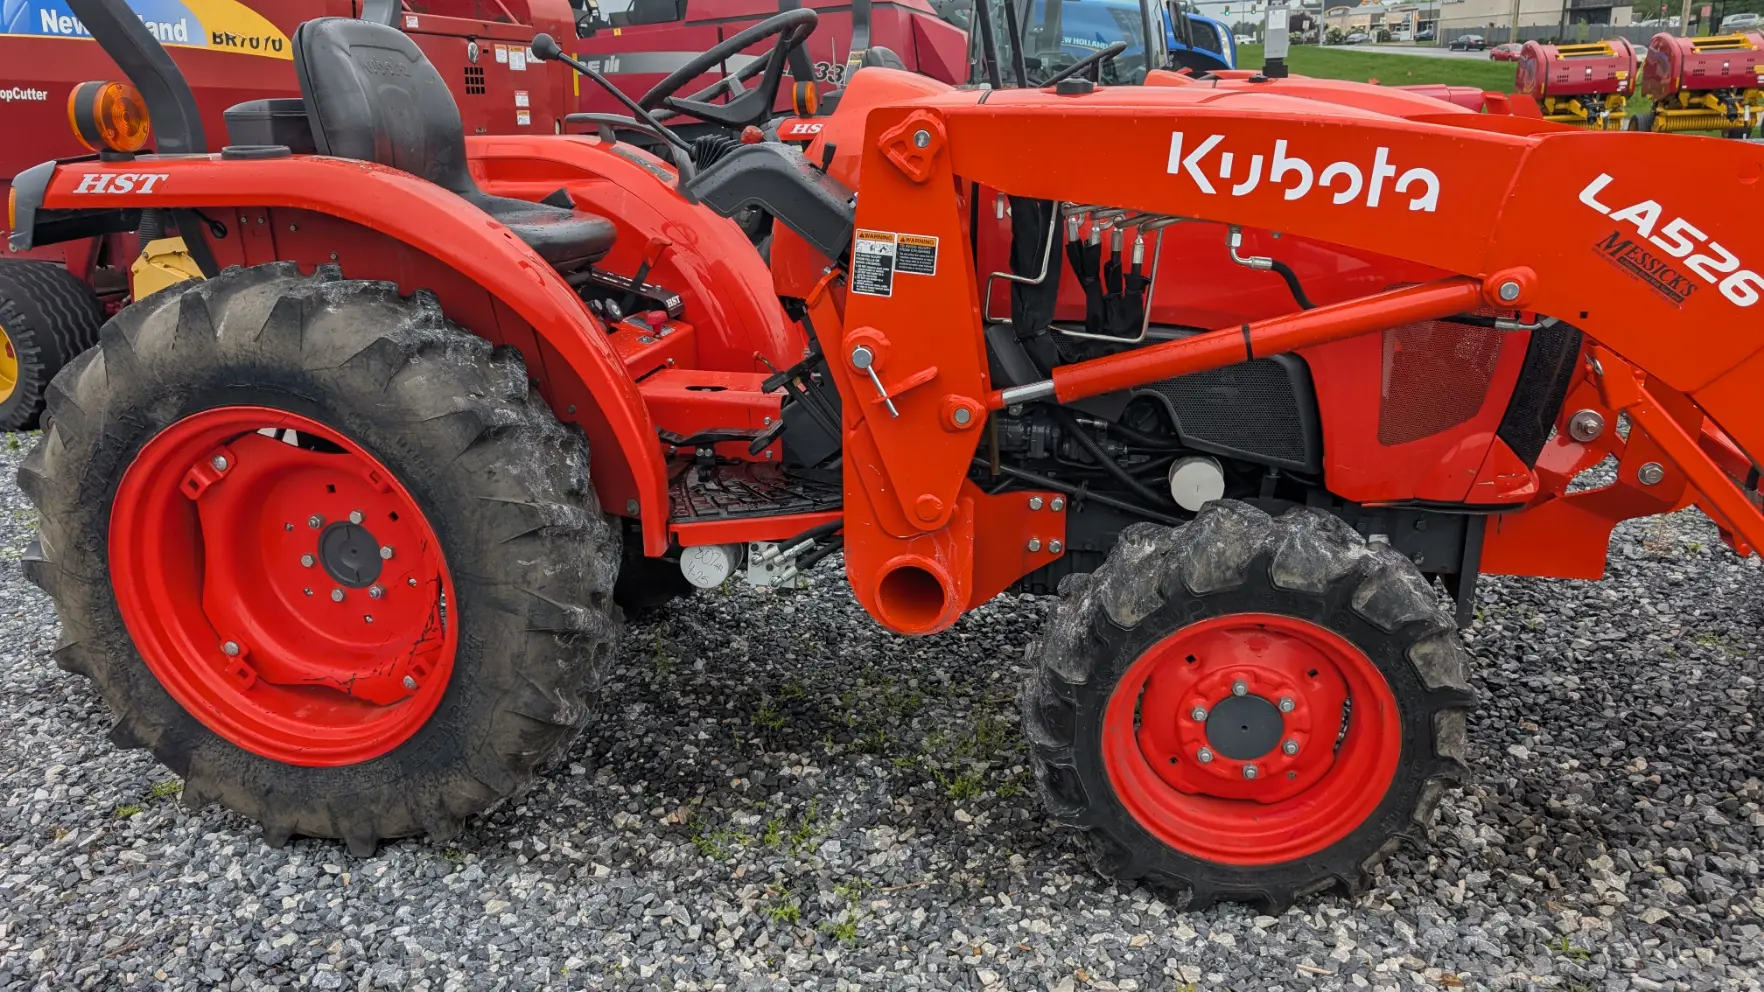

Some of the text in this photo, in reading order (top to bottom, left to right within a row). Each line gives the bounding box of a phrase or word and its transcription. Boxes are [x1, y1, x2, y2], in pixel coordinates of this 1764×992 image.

[790, 123, 824, 134] HS
[1166, 131, 1440, 212] Kubota
[72, 173, 170, 194] HST
[1578, 172, 1764, 307] LA526
[665, 294, 681, 308] HST
